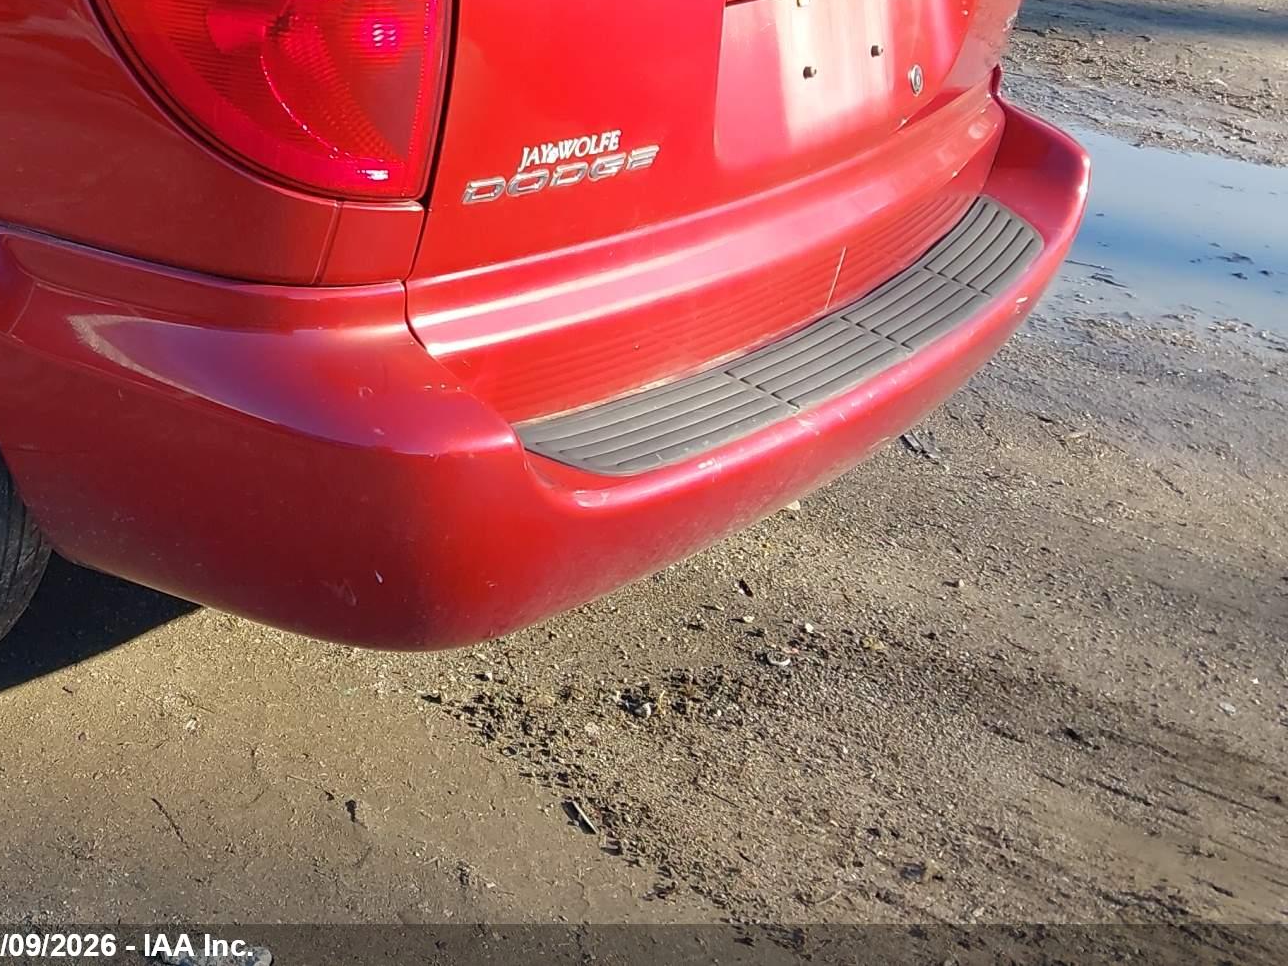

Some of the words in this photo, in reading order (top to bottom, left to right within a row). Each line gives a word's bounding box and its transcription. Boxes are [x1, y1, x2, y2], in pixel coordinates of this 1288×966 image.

[462, 145, 659, 204] DODGE
[518, 143, 554, 172] JAY
[559, 130, 621, 160] WOLFE
